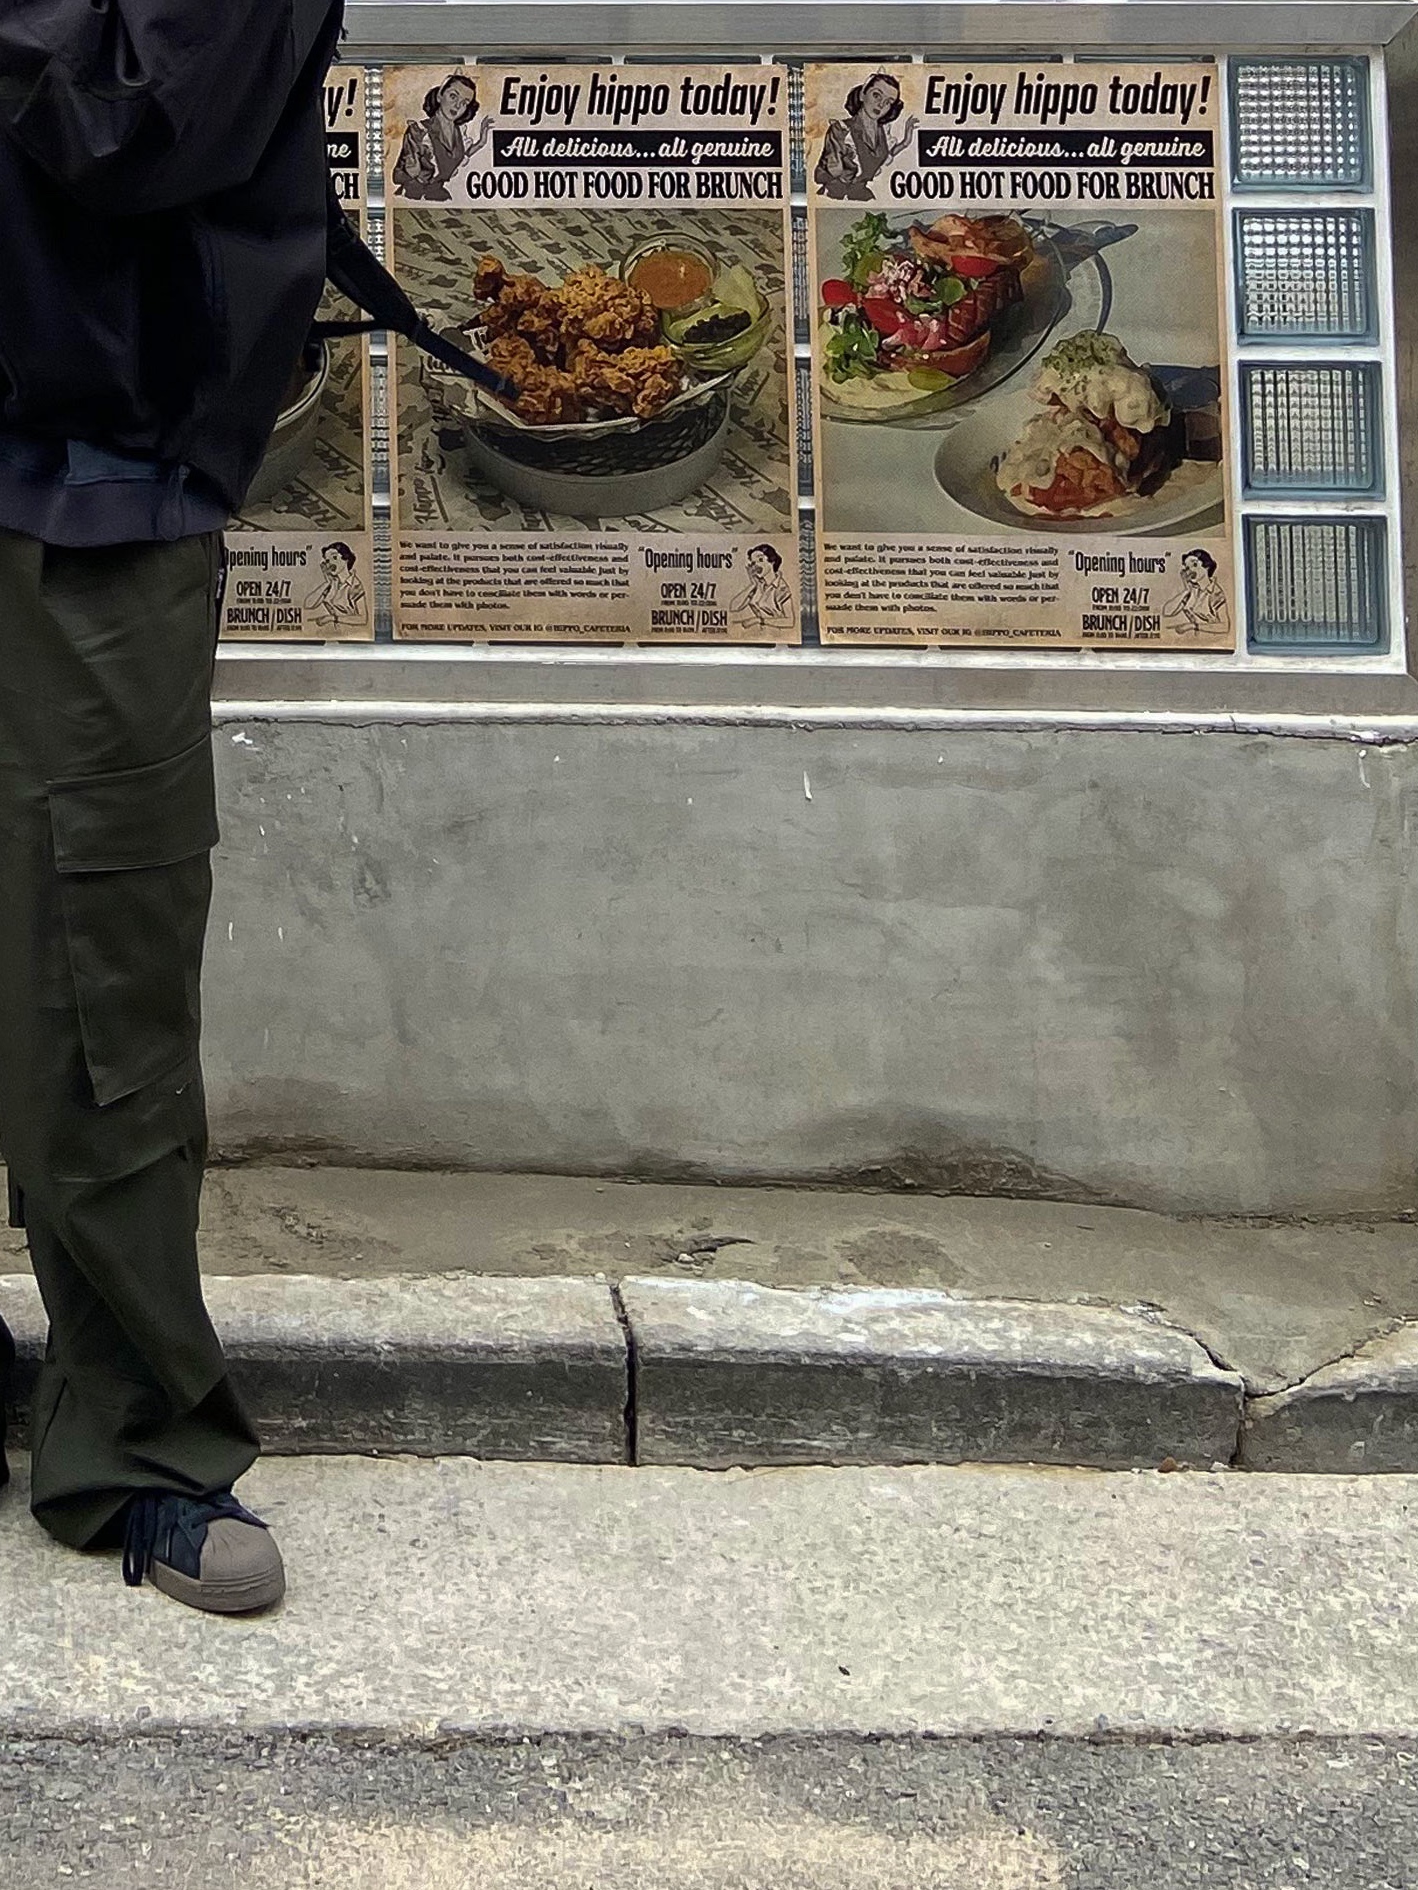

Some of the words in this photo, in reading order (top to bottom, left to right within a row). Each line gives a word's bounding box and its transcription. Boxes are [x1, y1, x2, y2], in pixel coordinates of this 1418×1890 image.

[500, 74, 581, 125] Enjoy
[588, 73, 670, 125] hippo
[680, 73, 780, 125] today!
[925, 73, 1007, 125] Enjoy
[1014, 72, 1098, 125] hippo
[1109, 72, 1211, 125] today!
[501, 137, 539, 157] All
[691, 137, 774, 164] genuine
[926, 136, 964, 157] All
[1121, 137, 1205, 165] genuine
[466, 171, 528, 199] GOOD
[534, 171, 578, 198] HOT
[583, 171, 643, 199] FOOD
[648, 171, 691, 198] FOR
[695, 172, 783, 199] BRUNCH
[890, 171, 954, 199] GOOD
[959, 171, 1005, 199] HOT
[1010, 171, 1071, 199] FOOD
[1076, 172, 1120, 199] FOR
[1125, 172, 1215, 200] BRUNCH
[451, 542, 470, 551] give
[528, 542, 538, 550] of
[540, 542, 592, 550] satisfaction
[226, 547, 268, 571] pening
[502, 554, 524, 562] both
[482, 566, 500, 574] that
[540, 565, 556, 573] feel
[619, 567, 629, 576] by
[237, 581, 261, 596] OPEN
[266, 580, 291, 597] 24/7
[400, 577, 434, 586] looking
[446, 577, 461, 585] the
[463, 578, 502, 587] products
[612, 579, 629, 587] that
[661, 583, 686, 598] OPEN
[691, 582, 716, 599] 24/7
[400, 590, 416, 598] you
[443, 589, 464, 597] have
[1092, 587, 1119, 603] OPEN
[1123, 588, 1149, 605] 24/7
[455, 601, 474, 609] with
[855, 603, 878, 611] them
[402, 624, 419, 633] FOR
